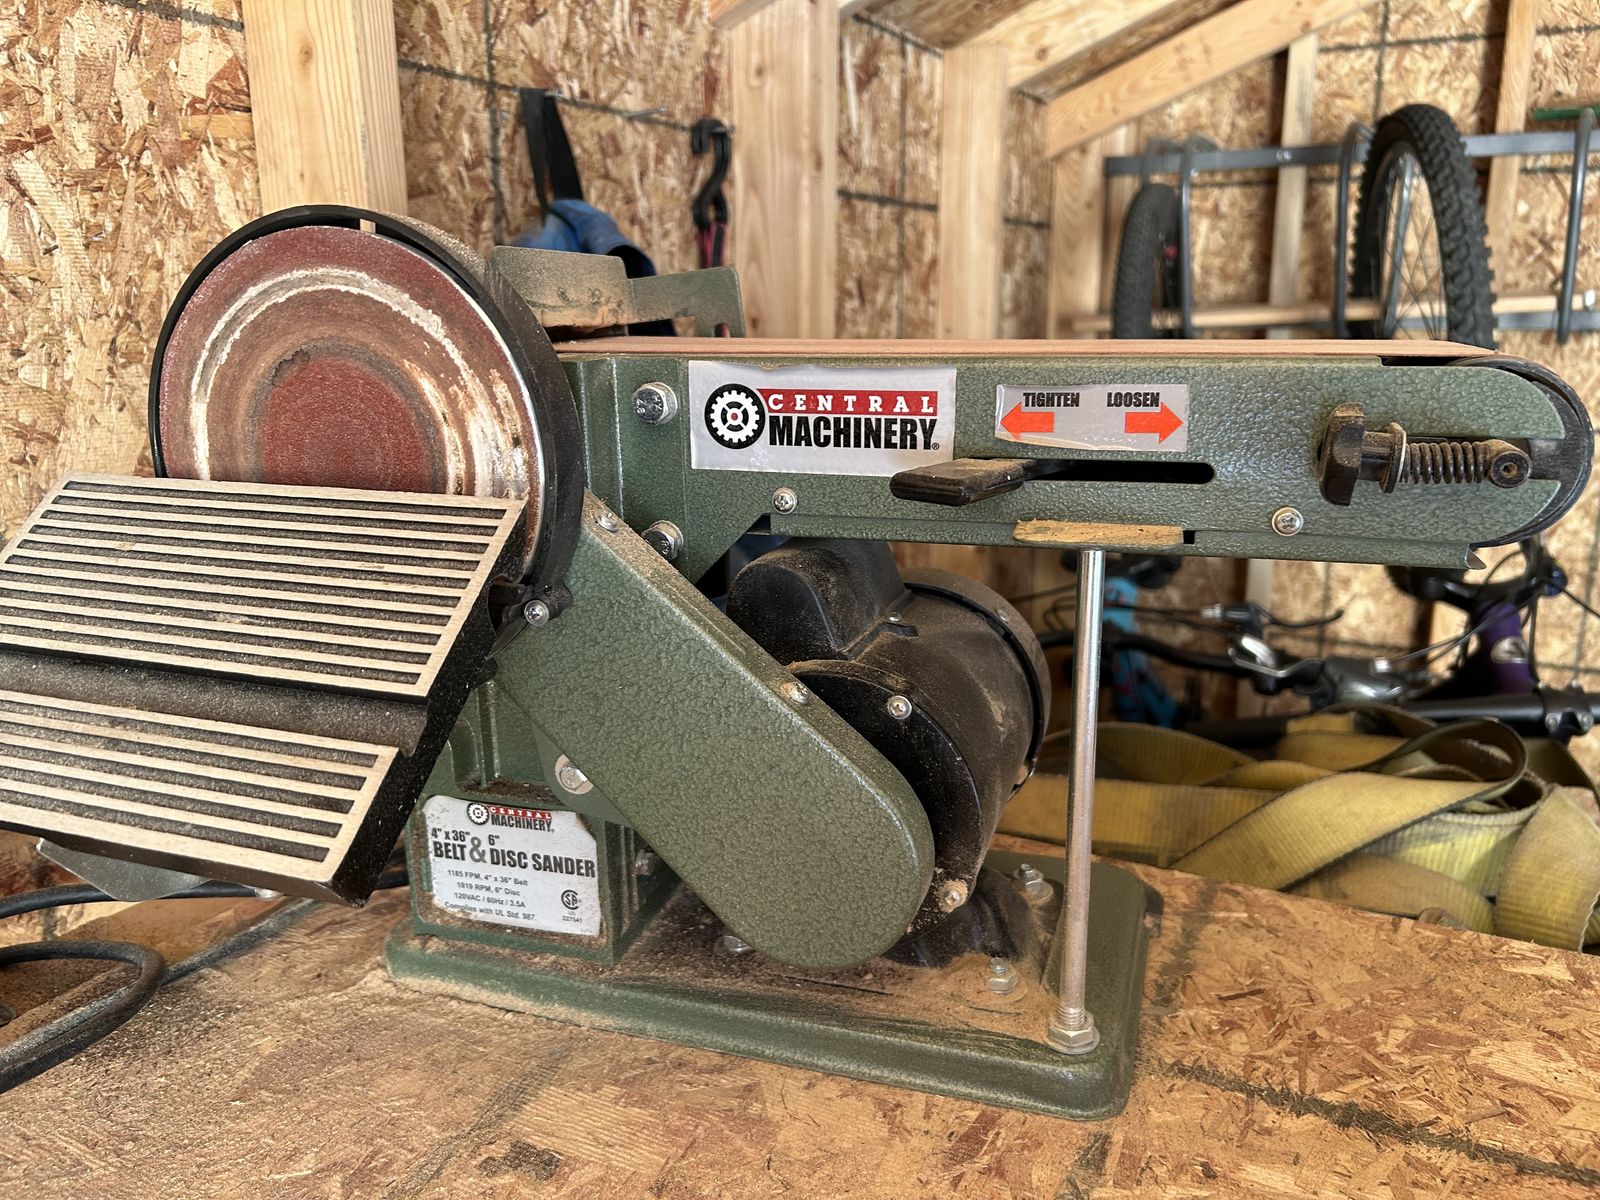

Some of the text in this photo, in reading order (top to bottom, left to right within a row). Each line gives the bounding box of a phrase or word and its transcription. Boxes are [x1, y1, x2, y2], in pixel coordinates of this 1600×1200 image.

[767, 393, 934, 413] CENTRAL
[1023, 391, 1160, 408] TIGHTEN LOOSEN
[489, 806, 551, 820] CENTRAL
[431, 827, 442, 839] 4"
[452, 829, 470, 842] 36"
[488, 834, 500, 846] 6"
[432, 836, 596, 878] BELT & DISC SANDER
[447, 869, 464, 877] 1185
[513, 878, 528, 886] Belt
[504, 888, 521, 896] Disc
[510, 899, 527, 908] 3.5A
[478, 907, 493, 915] with
[495, 909, 504, 917] UL
